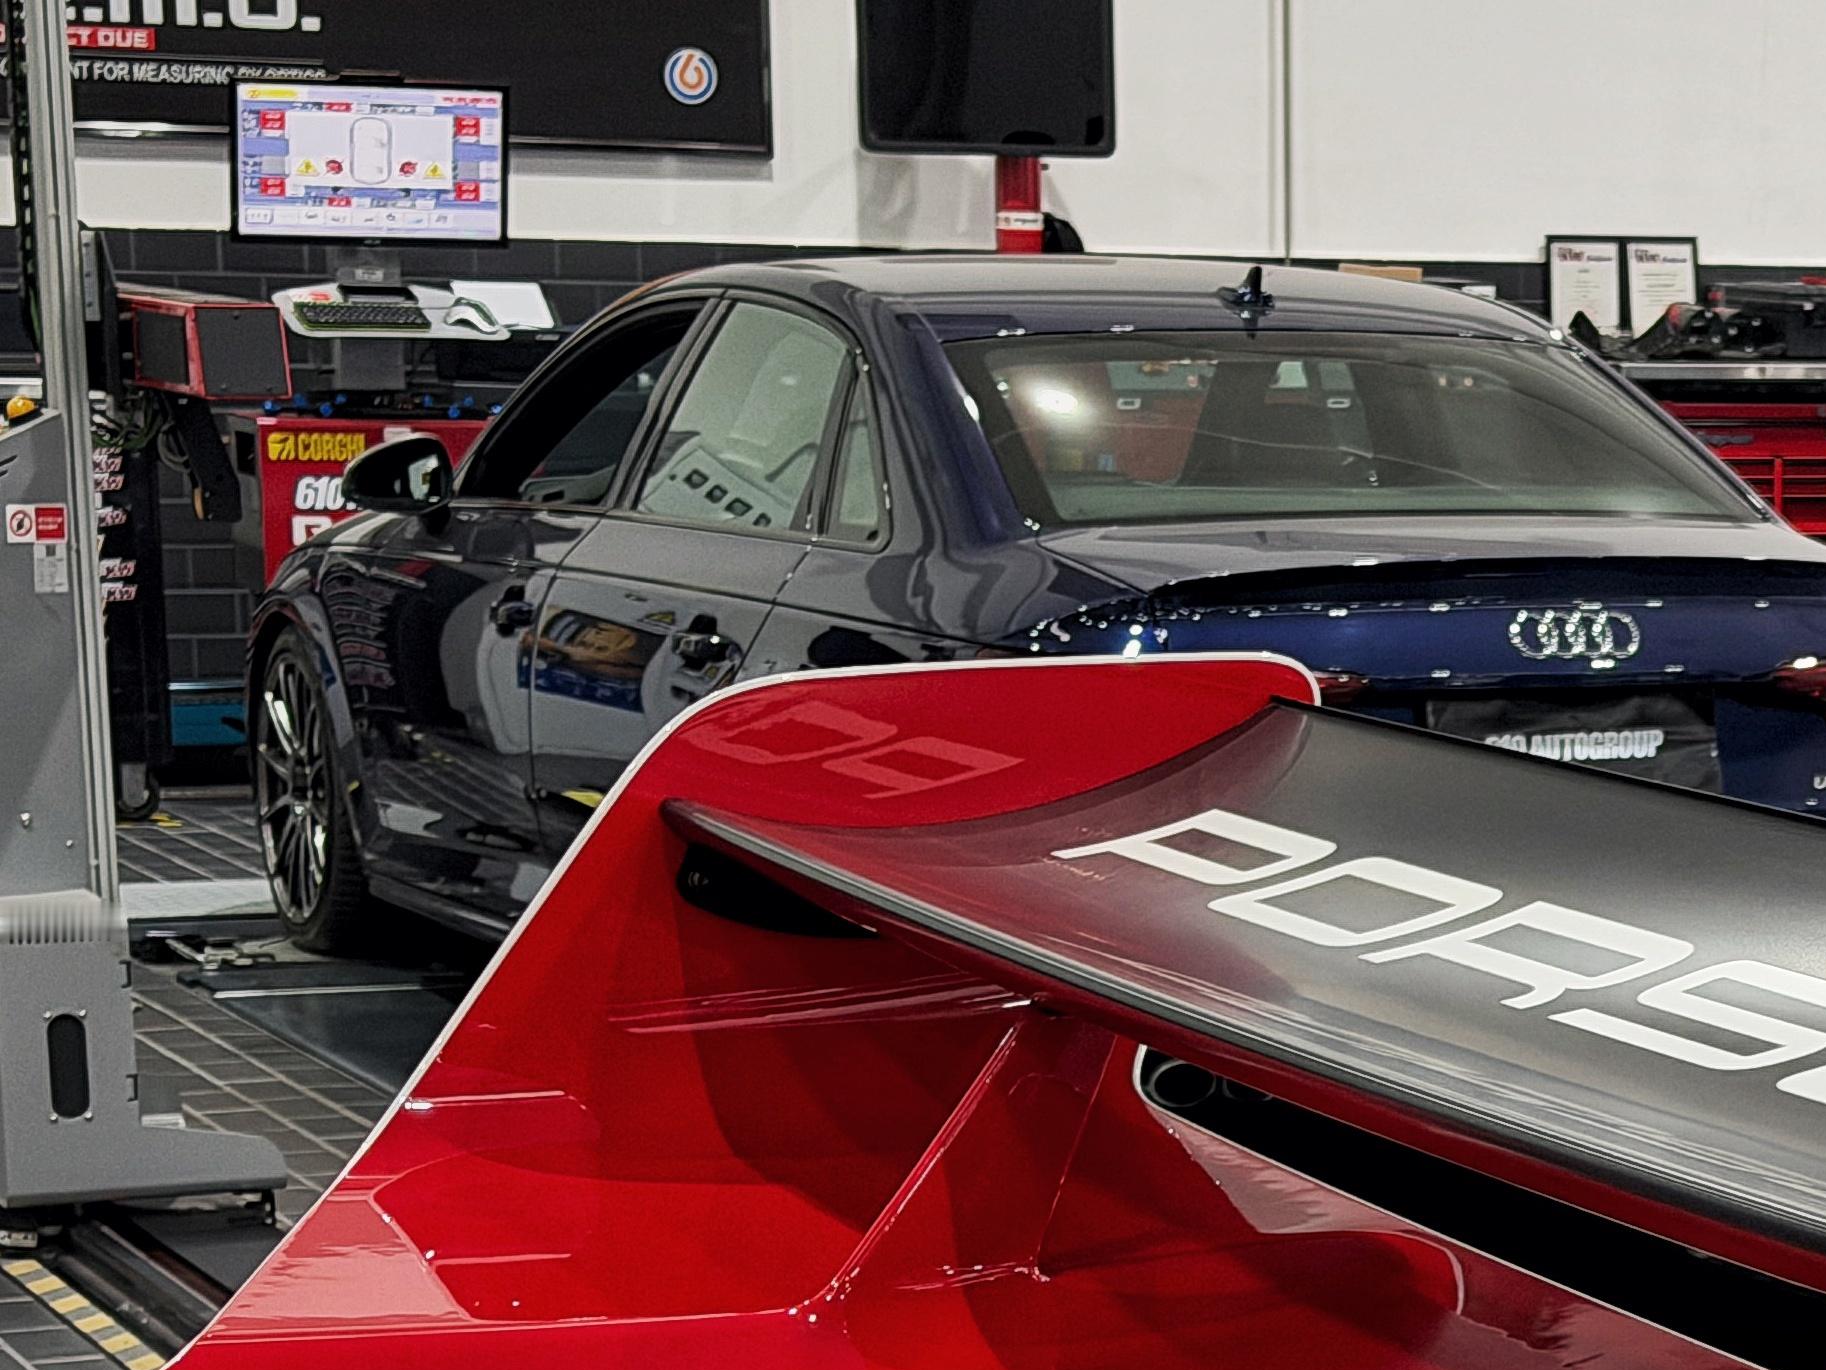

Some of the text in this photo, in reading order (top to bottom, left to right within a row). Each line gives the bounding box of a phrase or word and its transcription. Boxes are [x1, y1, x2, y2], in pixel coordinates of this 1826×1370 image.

[98, 30, 149, 48] DUE
[93, 62, 130, 82] FOR
[132, 63, 234, 86] MEASURING
[1529, 729, 1664, 761] AUTOGROUP
